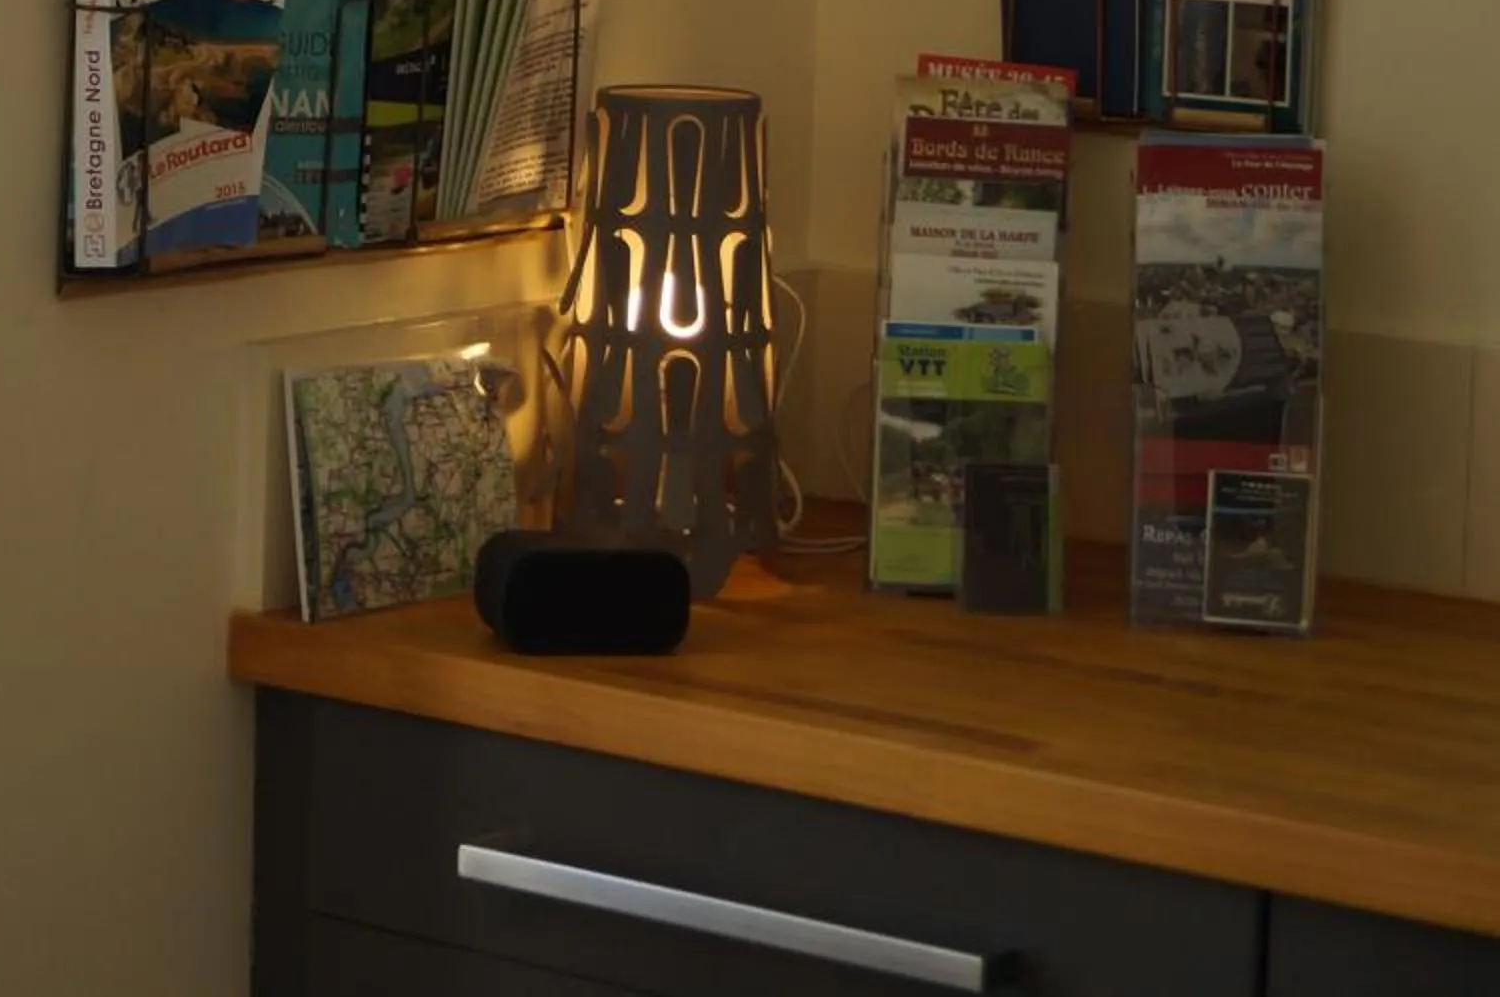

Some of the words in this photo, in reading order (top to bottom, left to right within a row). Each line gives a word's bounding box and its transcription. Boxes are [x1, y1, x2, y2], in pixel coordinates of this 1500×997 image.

[85, 50, 101, 103] Nord
[86, 111, 105, 210] Bretagne
[900, 359, 947, 377] VTT
